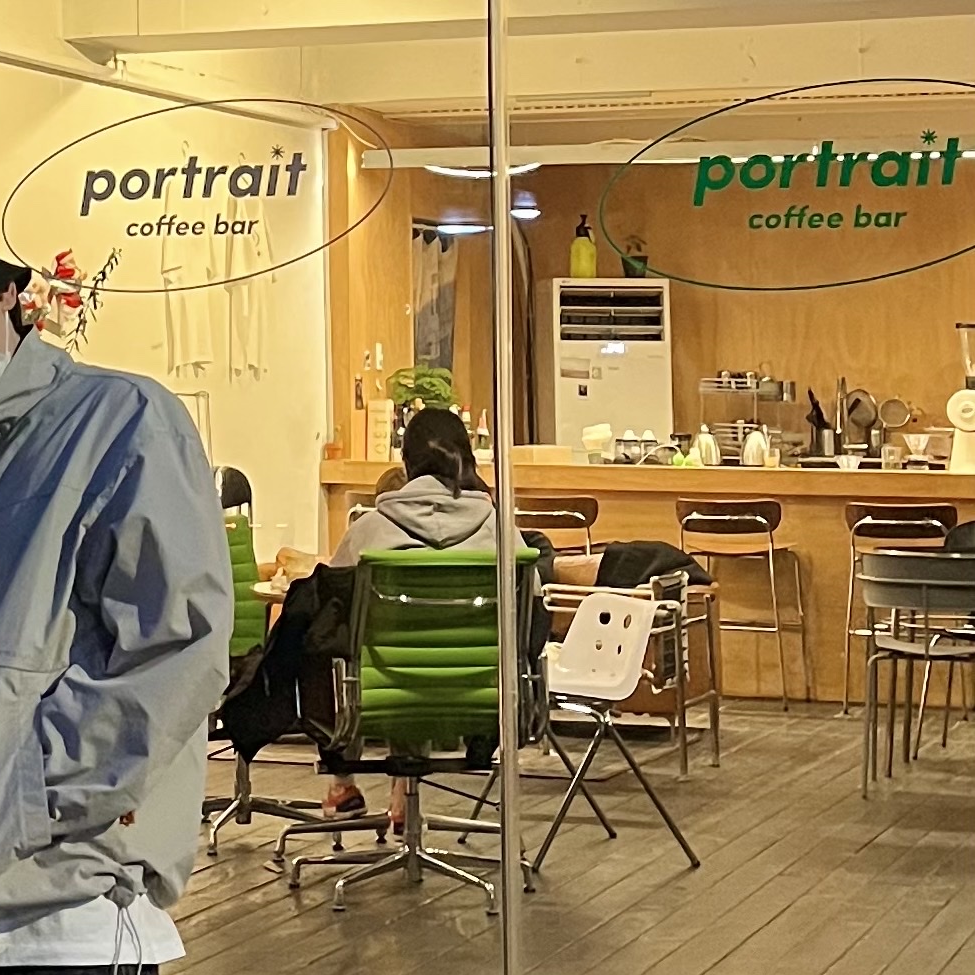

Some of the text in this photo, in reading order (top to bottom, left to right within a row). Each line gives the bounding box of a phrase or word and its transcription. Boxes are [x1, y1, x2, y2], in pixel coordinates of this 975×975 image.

[80, 144, 307, 216] portrait
[693, 129, 960, 206] portrait
[127, 214, 258, 237] coffee bar
[748, 204, 907, 229] coffee bar
